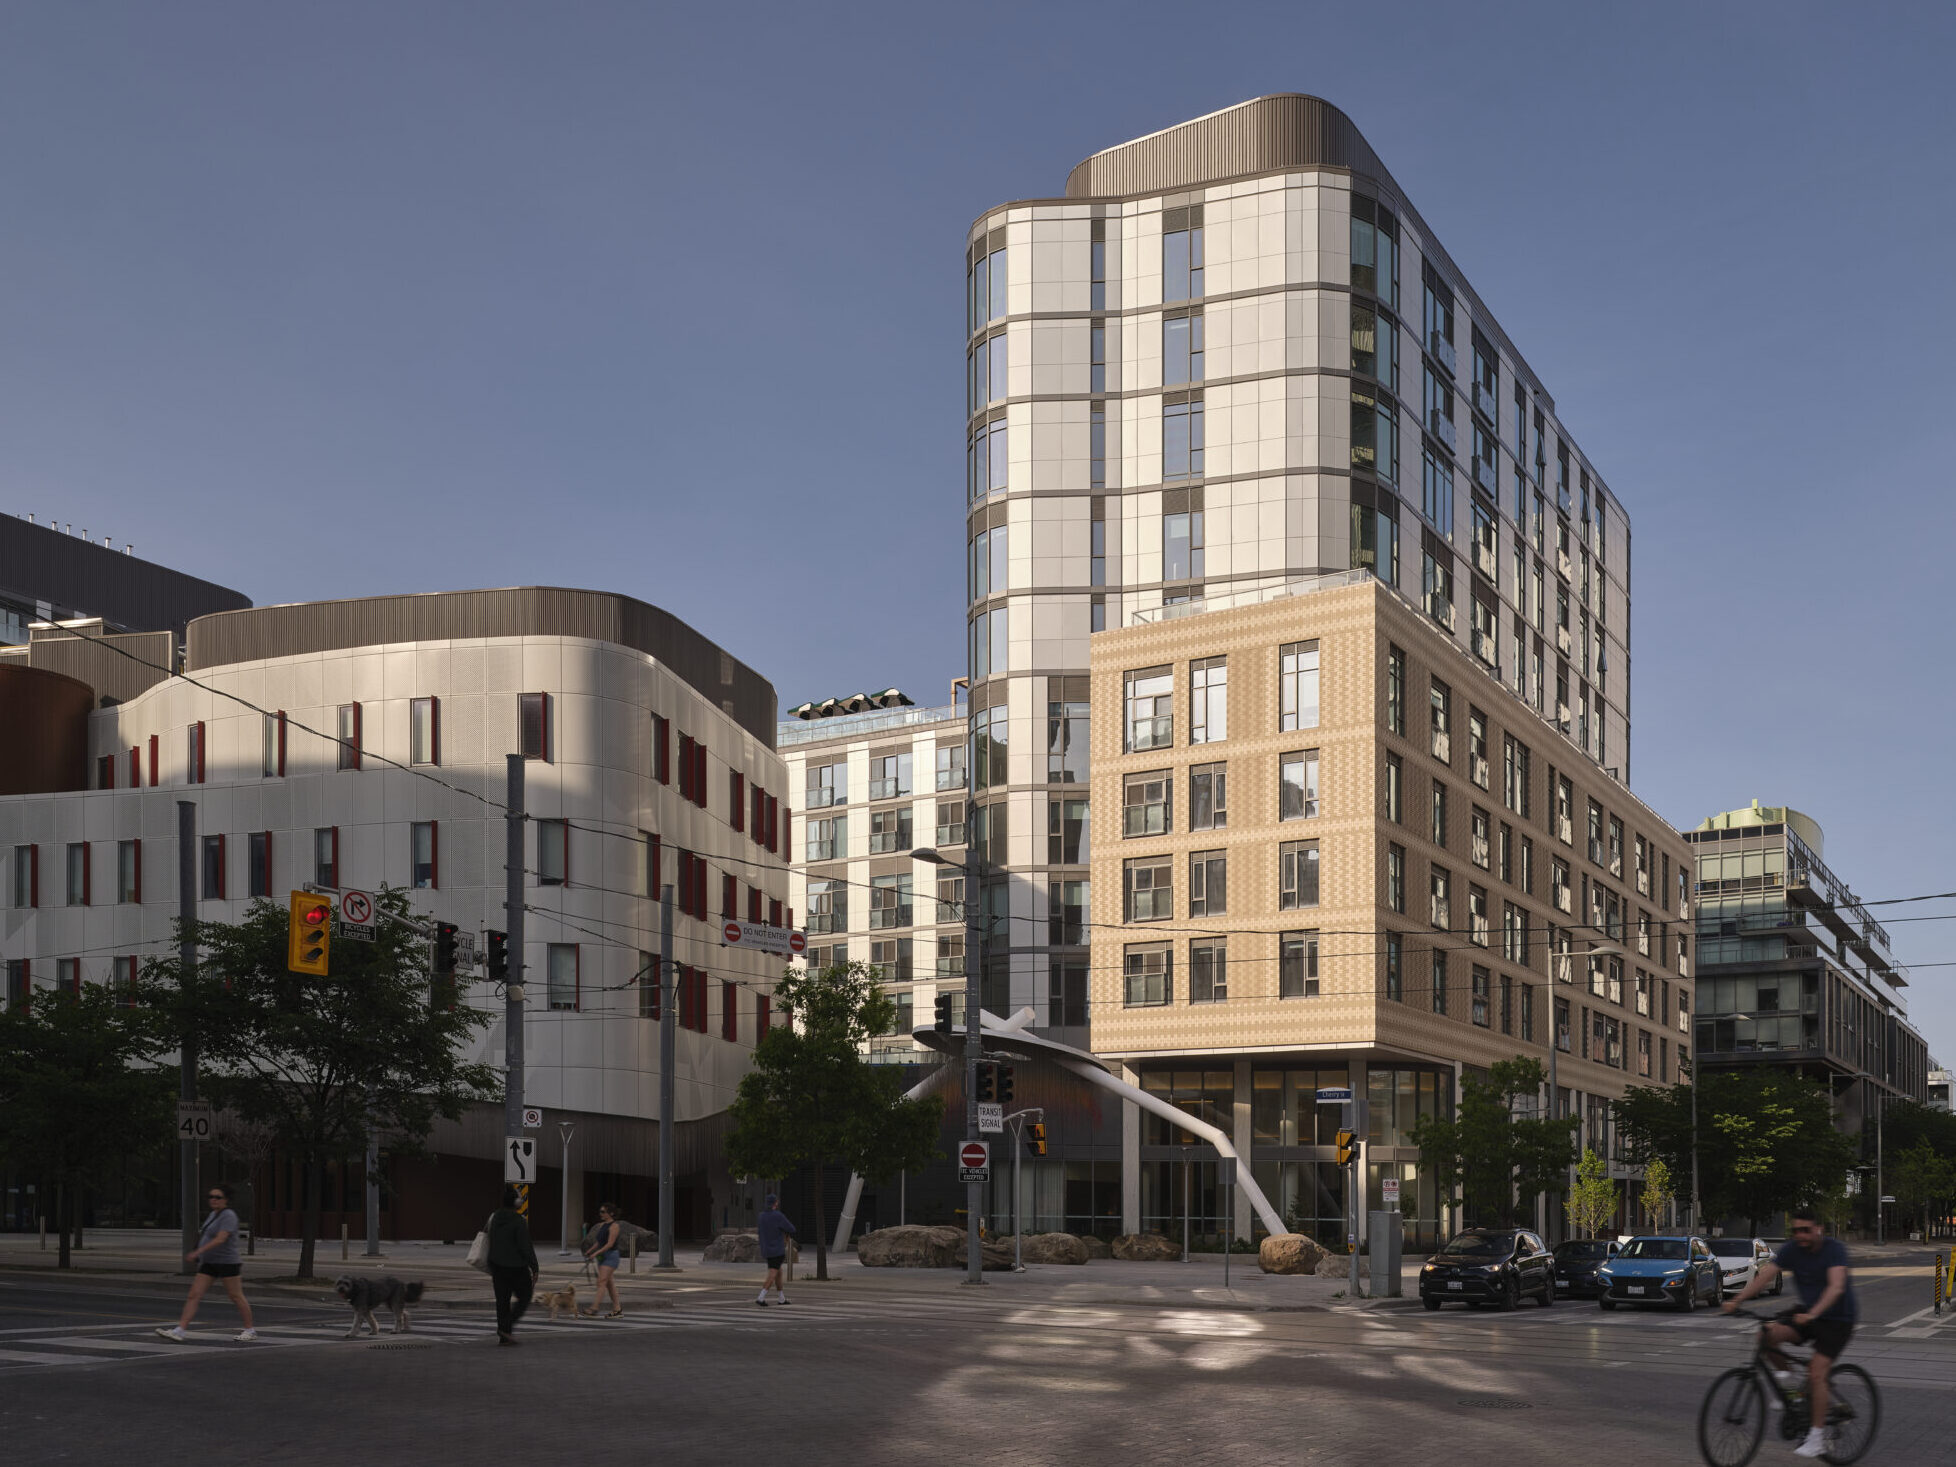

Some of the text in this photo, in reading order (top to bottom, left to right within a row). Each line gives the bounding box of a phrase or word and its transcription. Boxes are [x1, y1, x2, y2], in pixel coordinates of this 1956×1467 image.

[743, 927, 787, 941] DO NOT ENTER
[979, 1107, 1001, 1116] TRANSIT
[180, 1117, 208, 1136] 40
[981, 1118, 1001, 1128] SIGNAL
